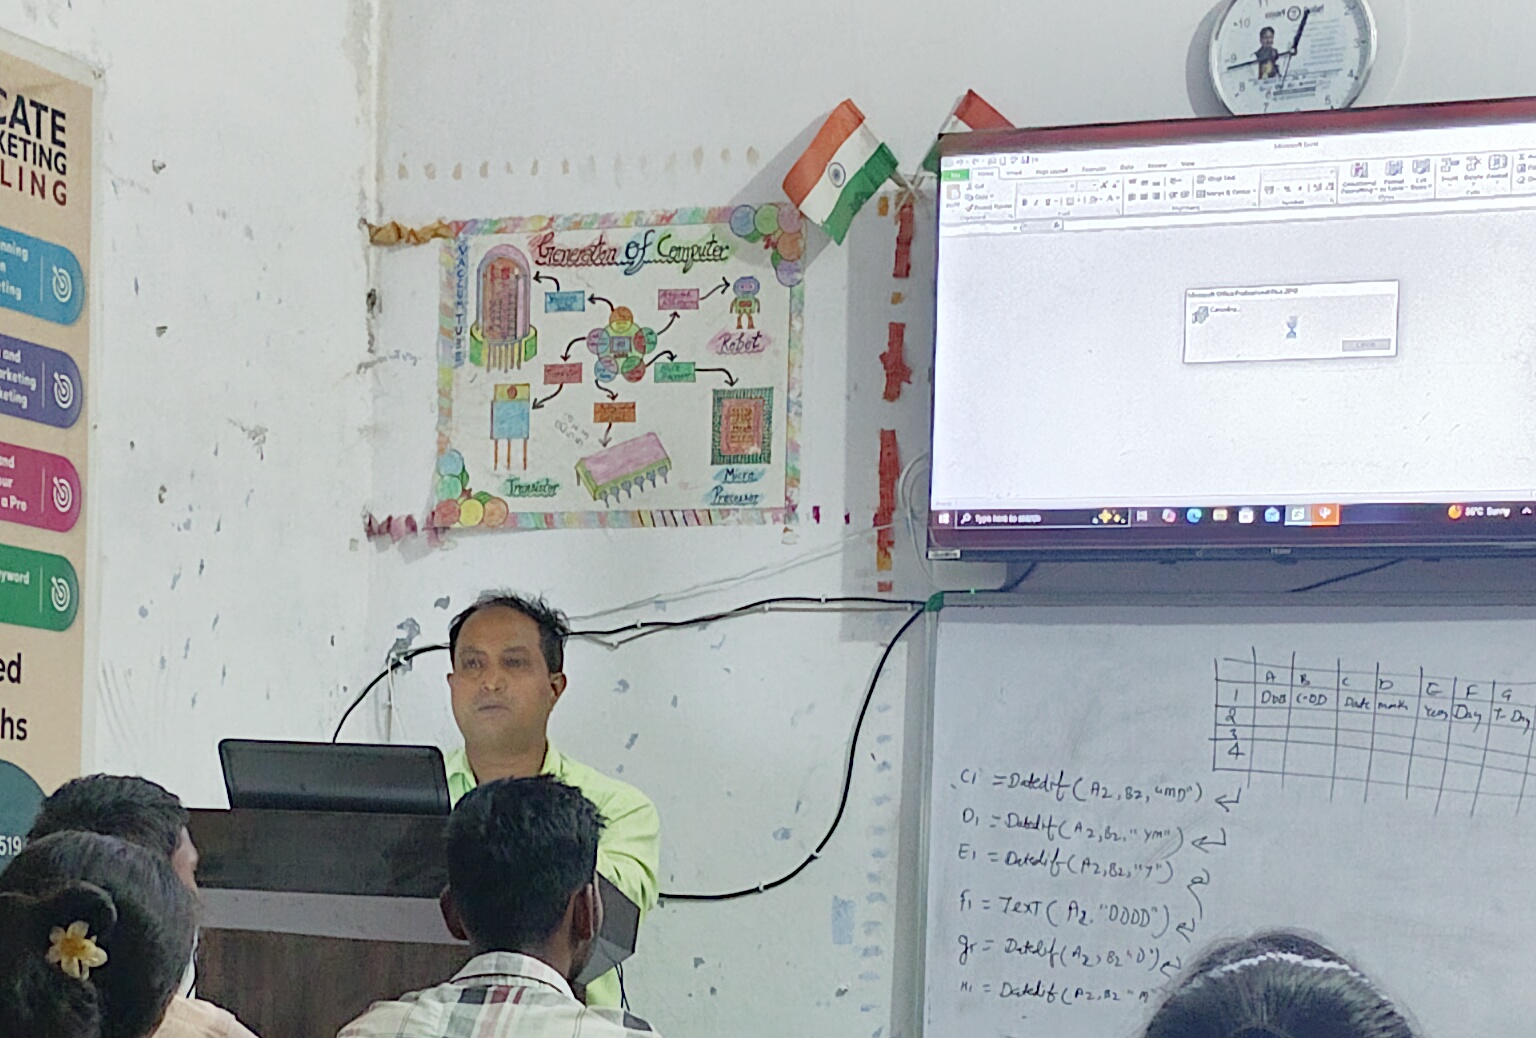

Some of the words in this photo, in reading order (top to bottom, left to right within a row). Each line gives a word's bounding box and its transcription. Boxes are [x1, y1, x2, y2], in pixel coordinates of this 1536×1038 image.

[655, 234, 730, 274] Computer
[718, 331, 764, 353] Robot
[2, 347, 21, 363] and
[724, 468, 754, 482] Micro
[0, 496, 10, 507] a
[10, 495, 27, 512] Pro
[975, 513, 992, 526] Type
[1009, 514, 1018, 524] to
[1018, 513, 1042, 525] search
[1265, 670, 1276, 683] A
[1233, 688, 1239, 702] 1
[1225, 708, 1237, 725] 2
[1230, 728, 1238, 741] 3
[1227, 741, 1246, 760] 4
